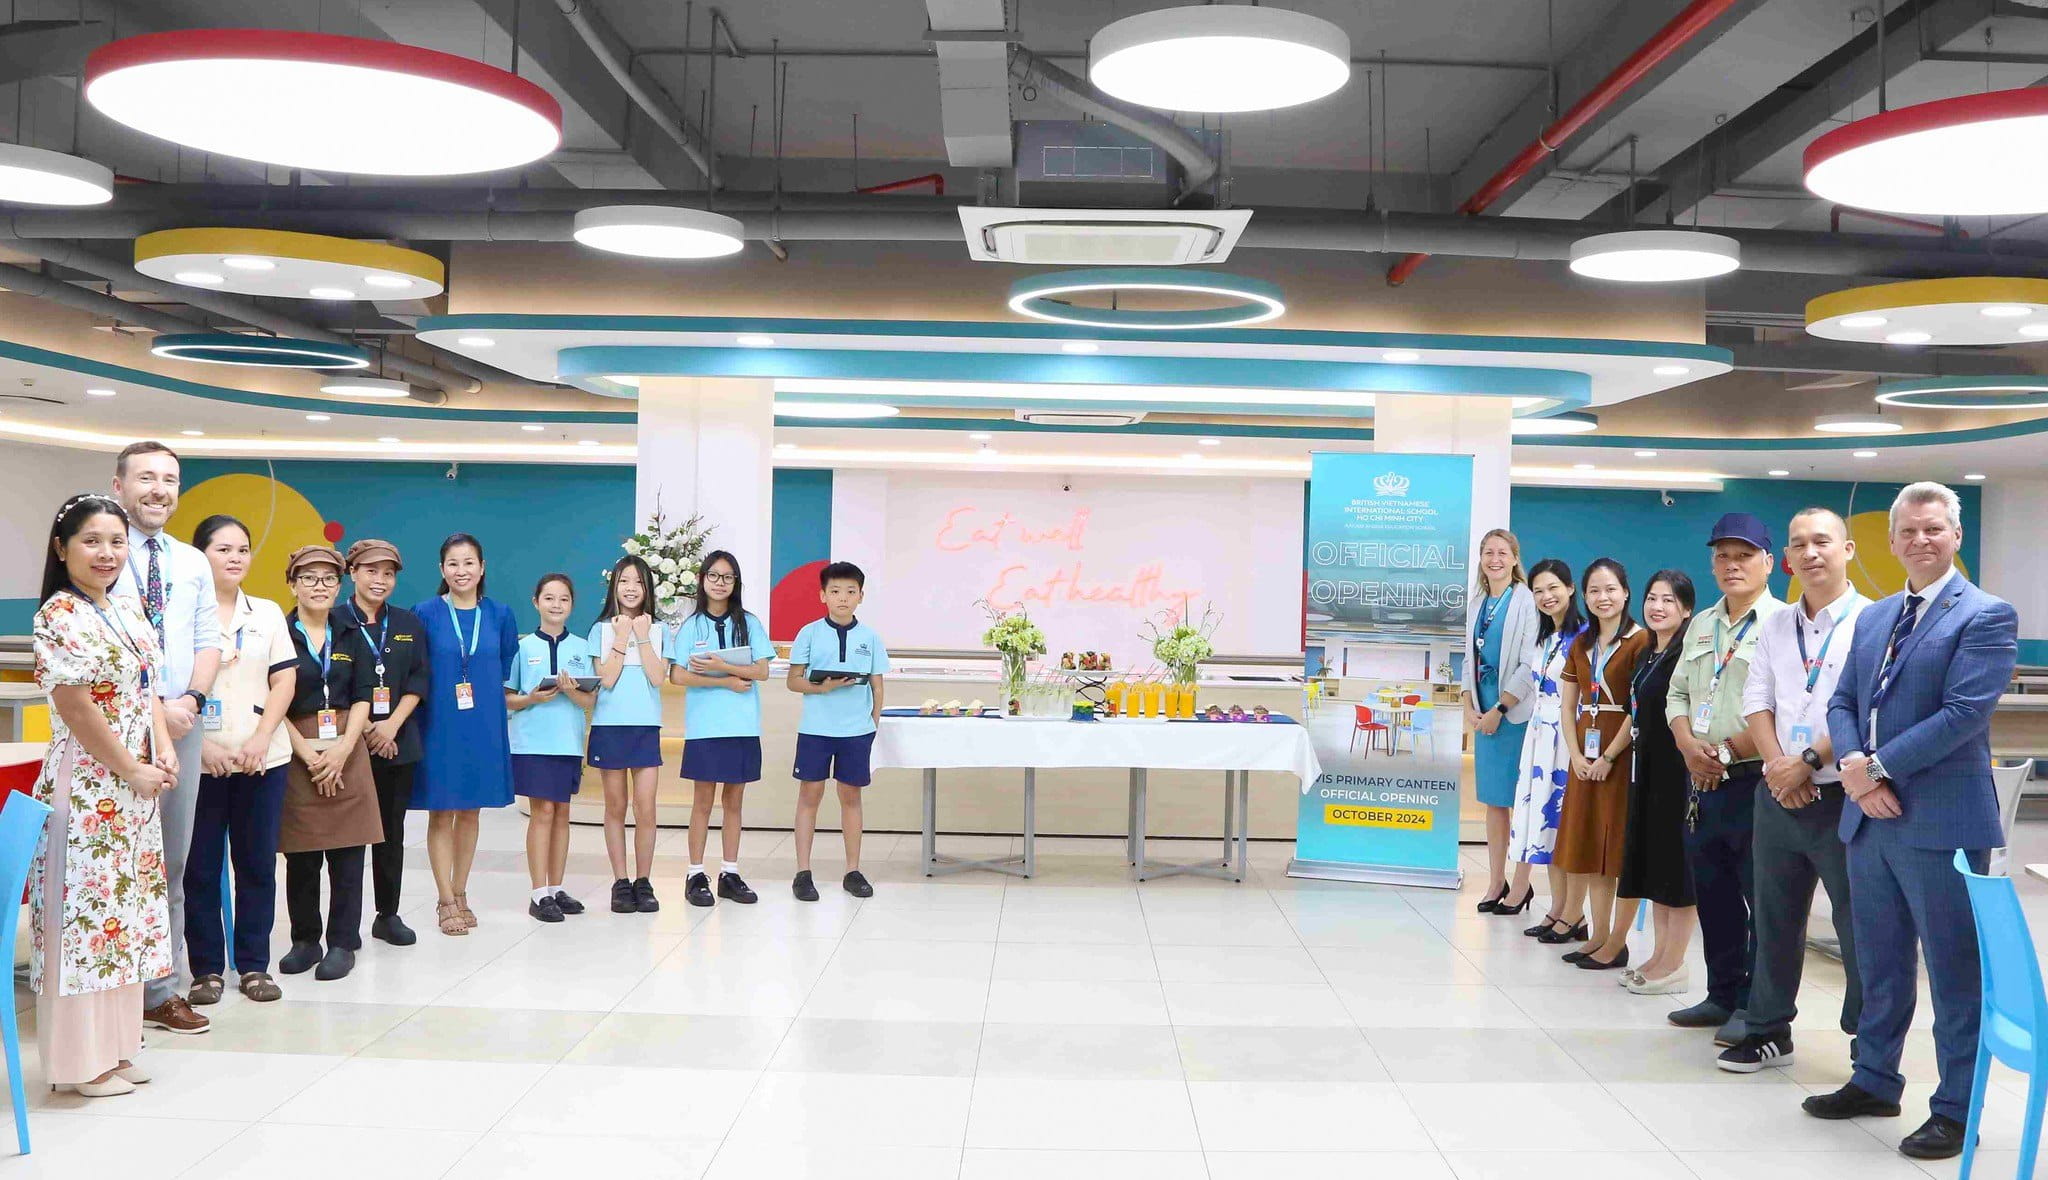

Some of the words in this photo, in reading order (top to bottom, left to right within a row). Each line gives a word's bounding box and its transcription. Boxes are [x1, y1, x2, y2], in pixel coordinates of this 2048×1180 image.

[1344, 506, 1405, 515] INTERNATIONAL
[1406, 508, 1438, 516] SCHOOL
[1382, 500, 1429, 508] VIETNAMESE
[936, 504, 1016, 551] Eat
[1019, 506, 1091, 551] well
[1312, 541, 1464, 569] OFFICIAL
[987, 564, 1067, 611] Eat
[1066, 560, 1202, 627] healthy
[1311, 580, 1464, 608] OPENING
[1315, 774, 1333, 784] VIS
[1336, 774, 1393, 787] PRIMARY
[1396, 778, 1456, 791] CANTEEN
[1320, 788, 1377, 802] OFFICIAL
[1380, 792, 1439, 805] OPENING
[1332, 809, 1393, 822] OCTOBER
[1396, 813, 1426, 824] 2024
